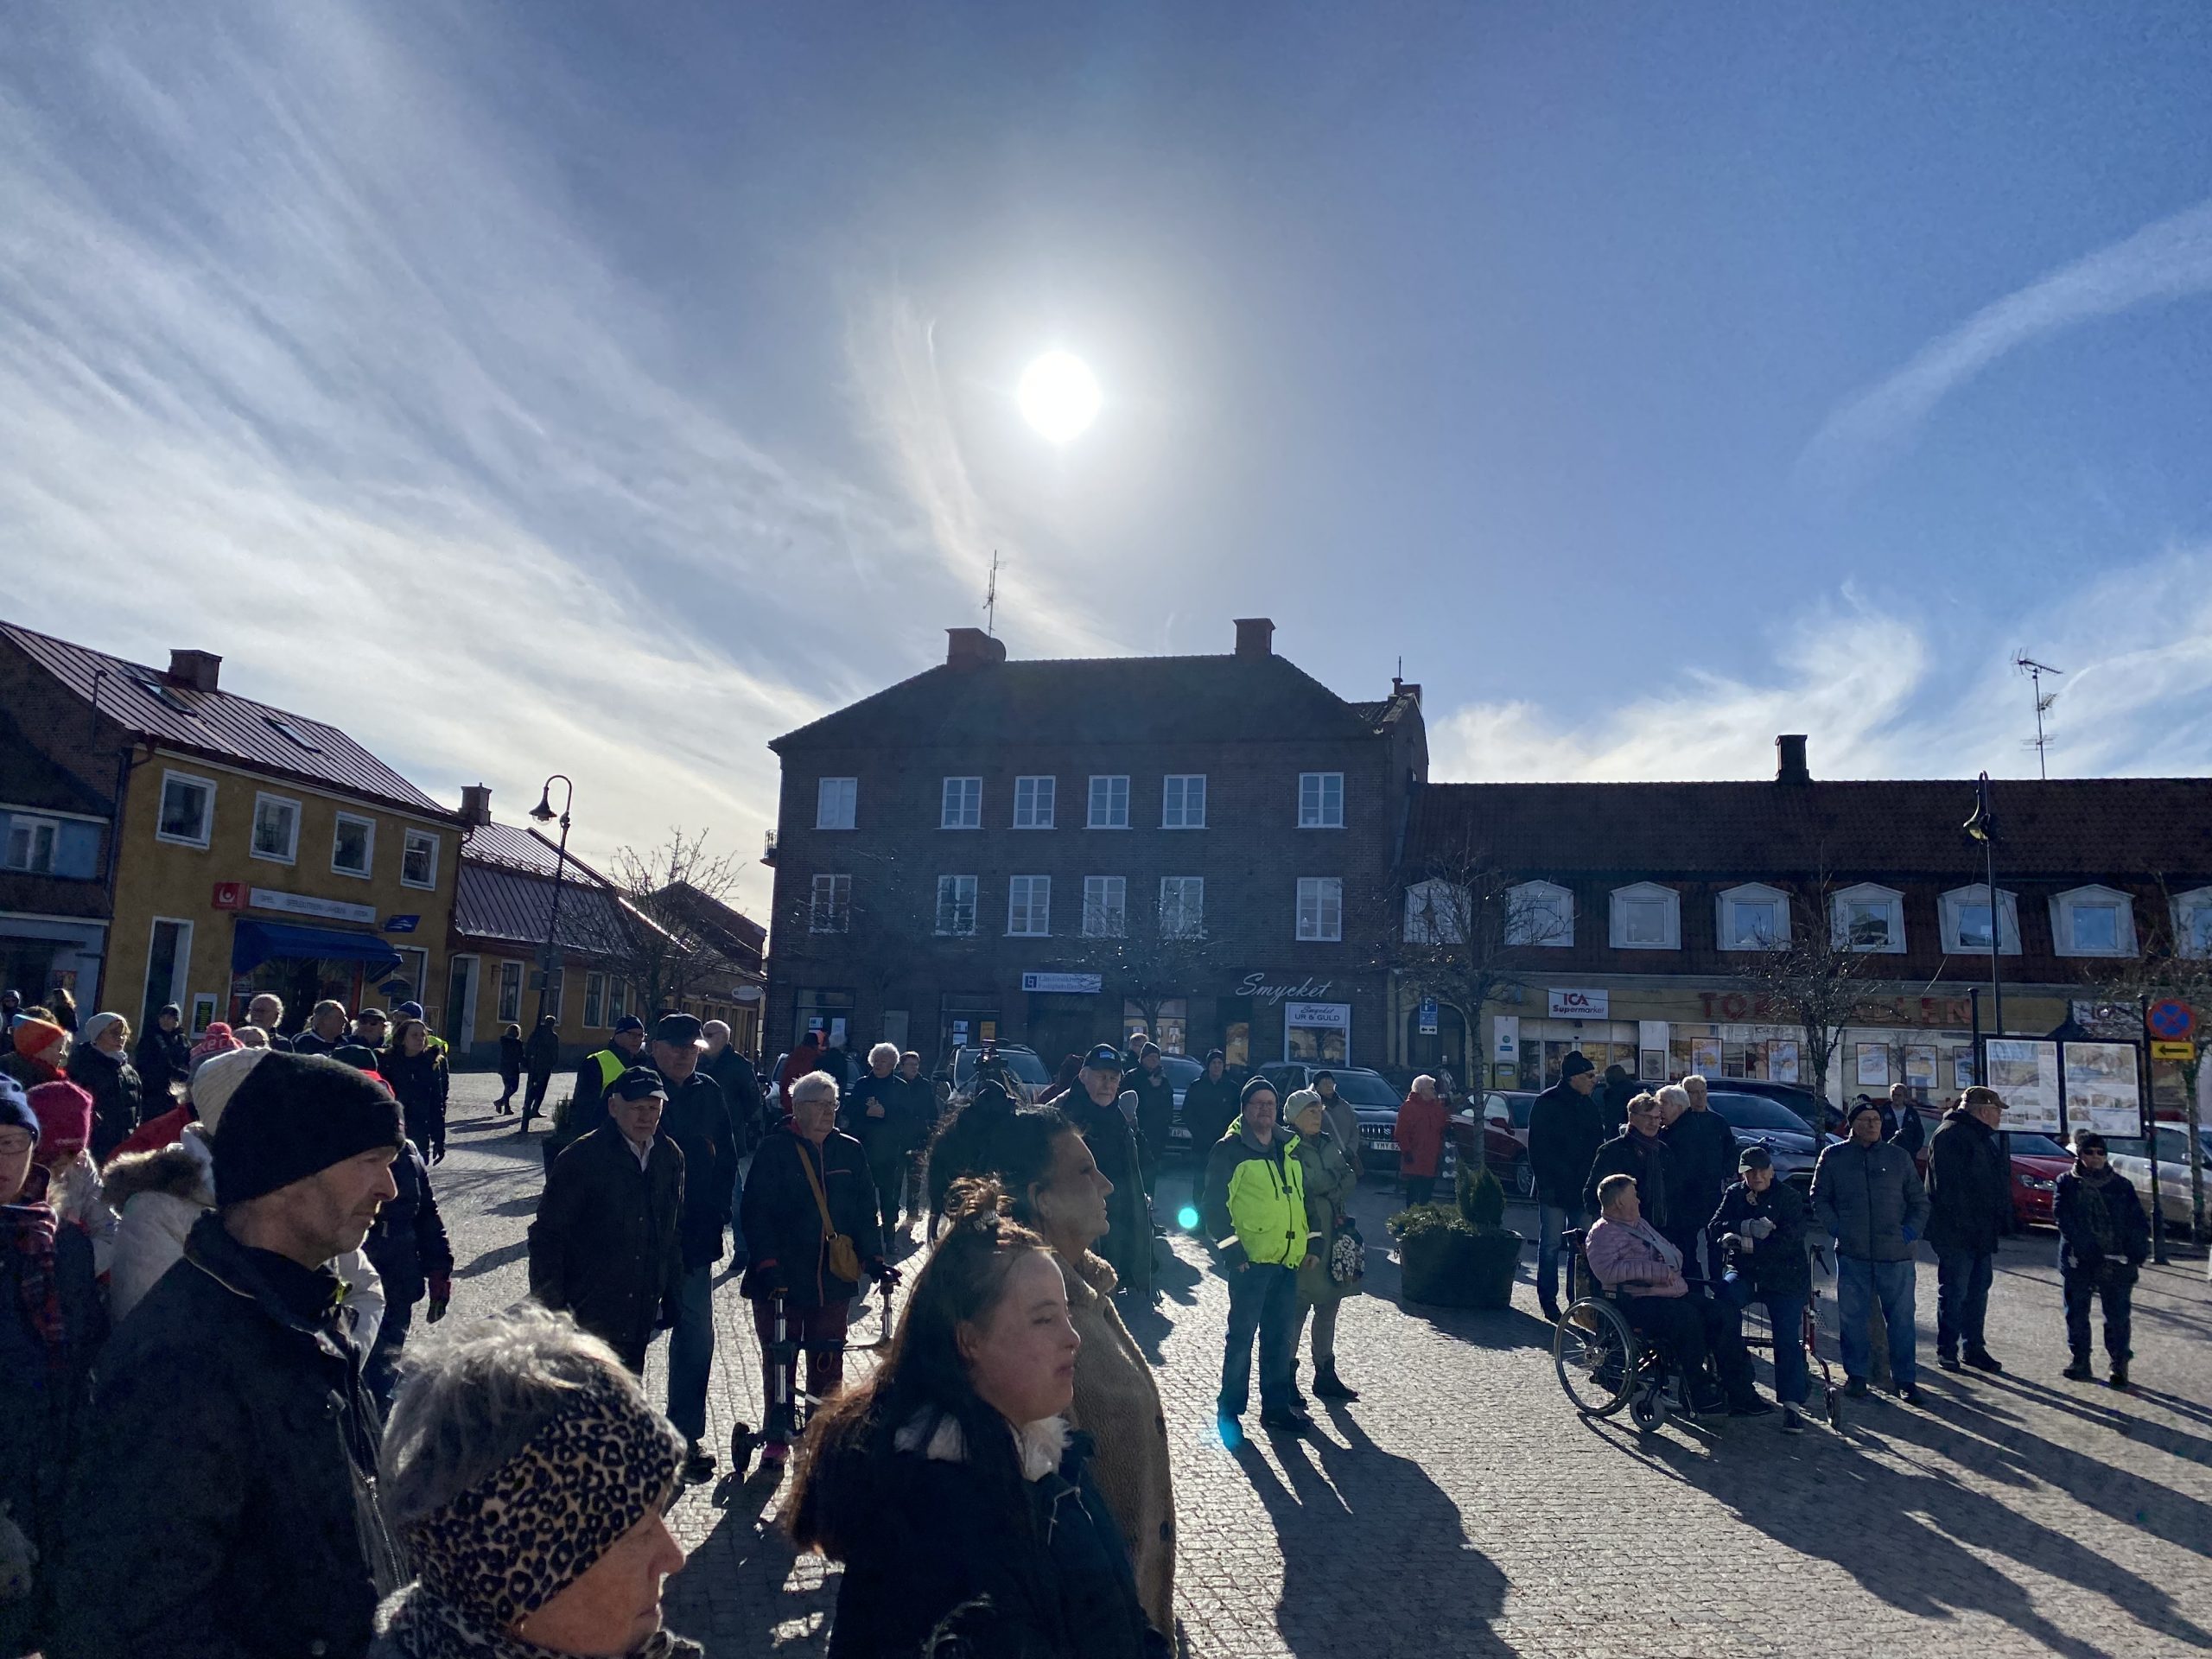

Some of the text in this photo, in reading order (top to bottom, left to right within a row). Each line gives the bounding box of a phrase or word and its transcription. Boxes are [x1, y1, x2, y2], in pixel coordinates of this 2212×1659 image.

[1235, 973, 1332, 1006] Smycket
[1563, 993, 1589, 1006] ICA
[1553, 1005, 1605, 1014] Supermarket
